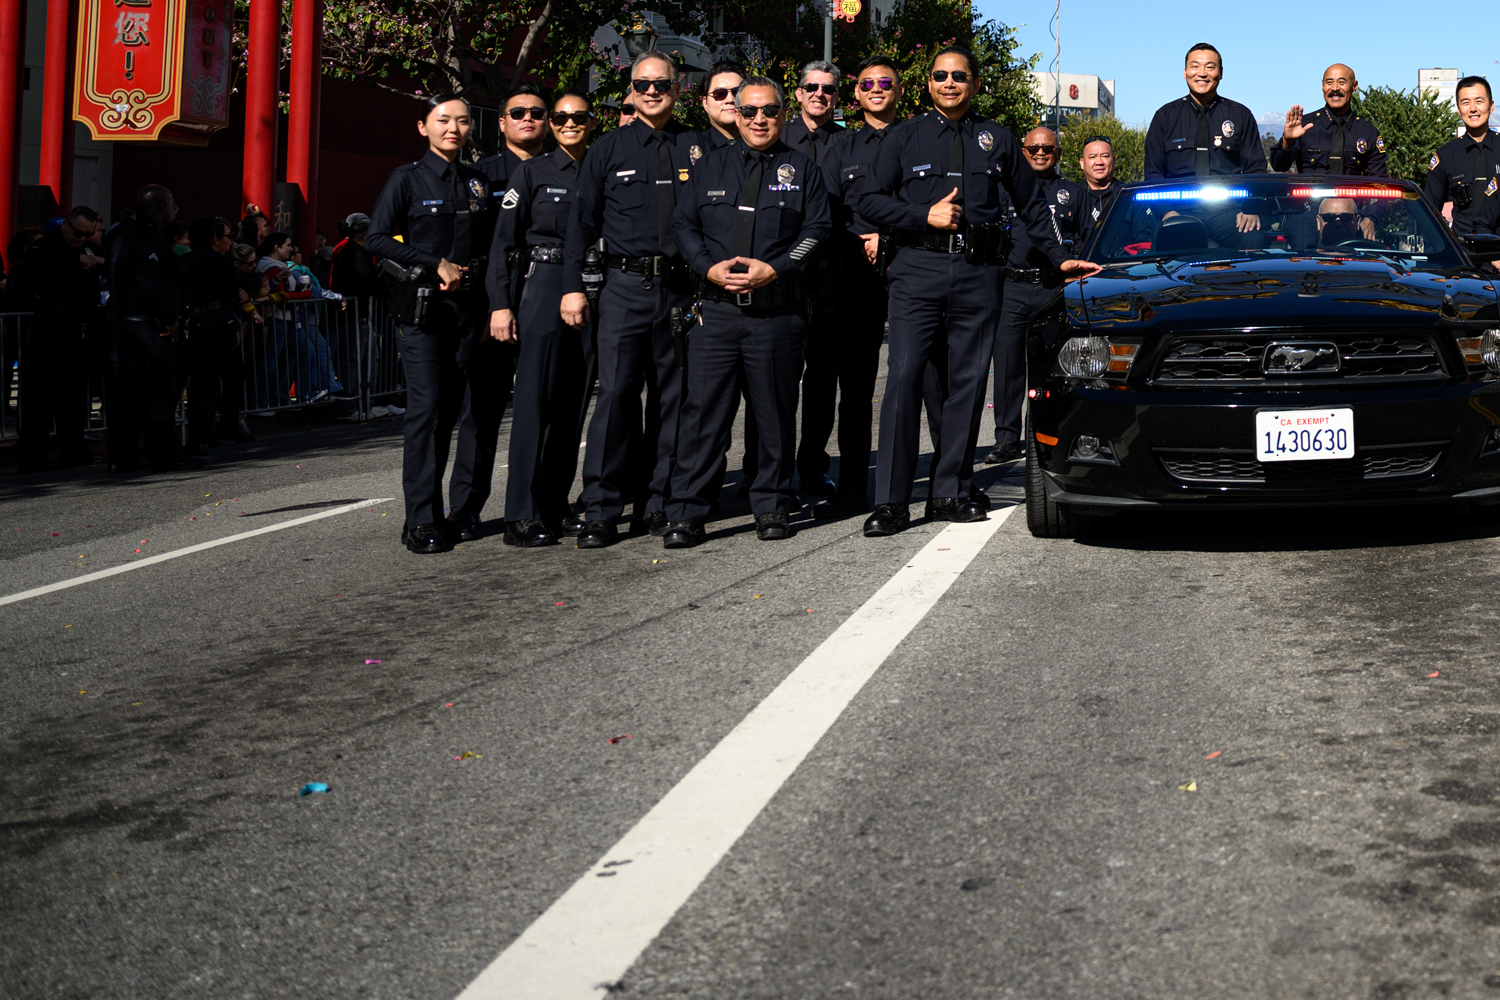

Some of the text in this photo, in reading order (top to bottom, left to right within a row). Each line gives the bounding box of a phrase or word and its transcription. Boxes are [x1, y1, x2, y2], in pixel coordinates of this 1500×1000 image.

[274, 200, 292, 233] 和
[1280, 417, 1330, 426] CA EXEMPT
[1264, 428, 1348, 454] 1430630
